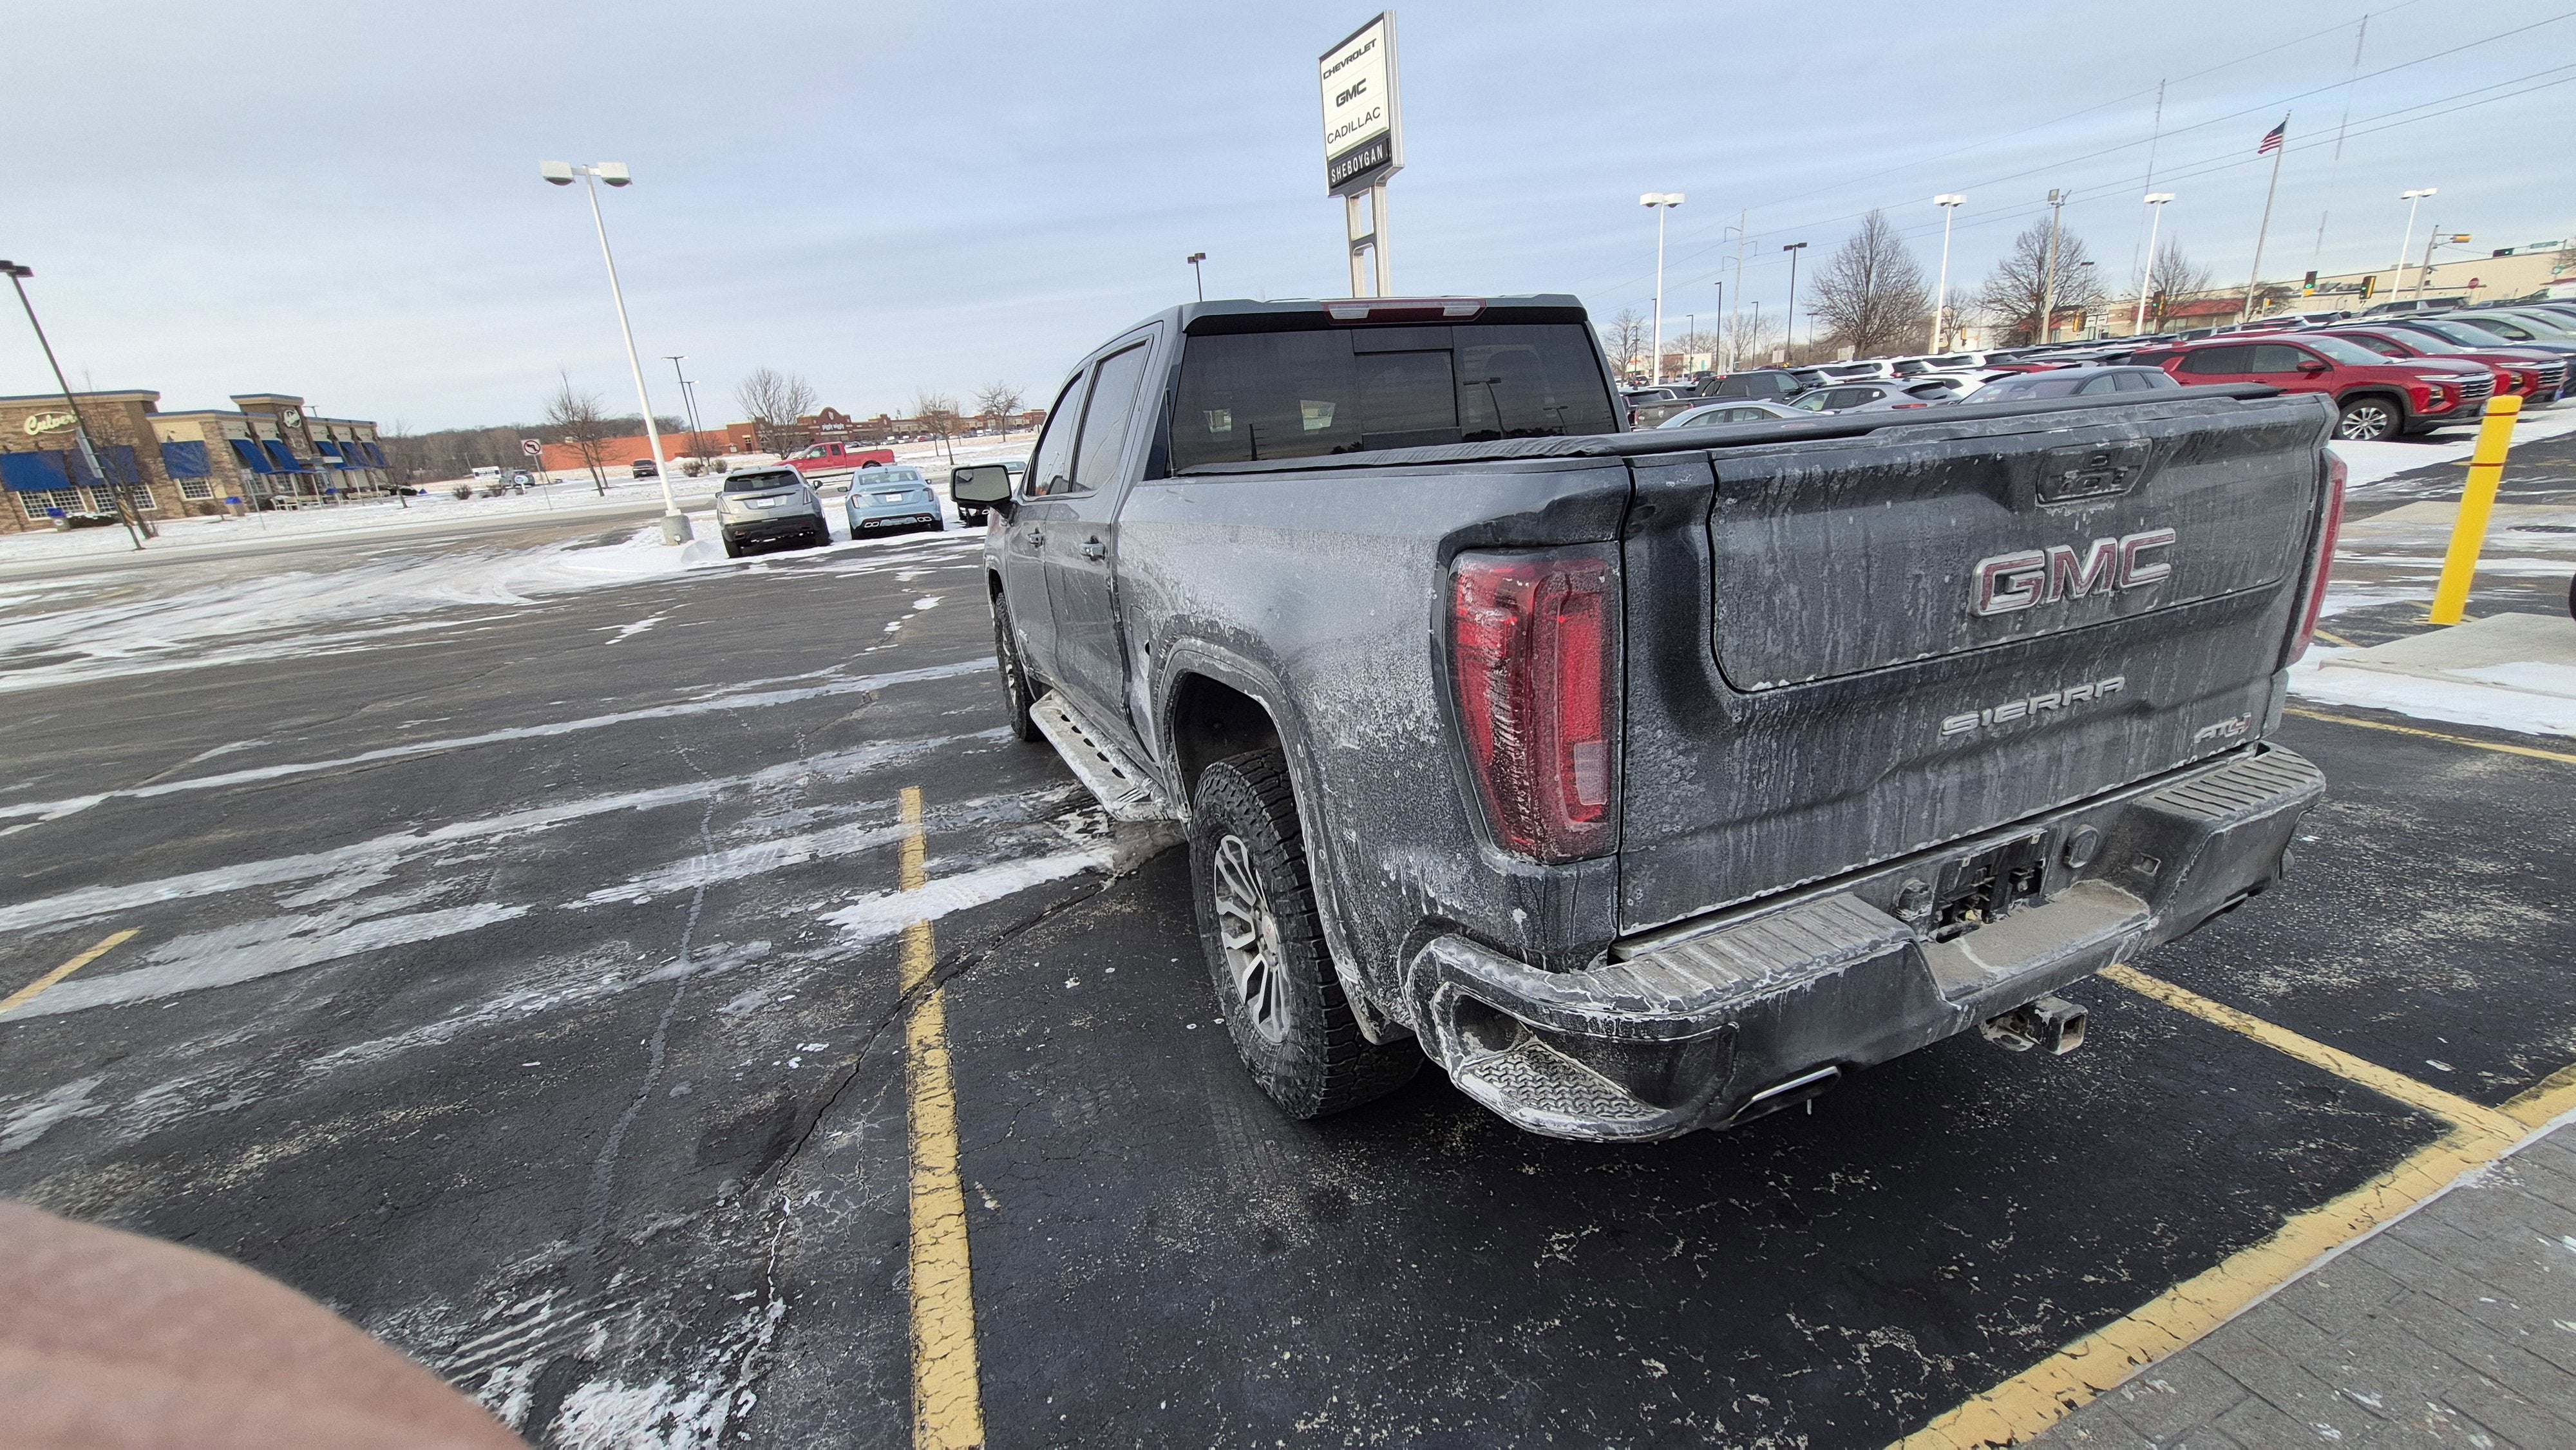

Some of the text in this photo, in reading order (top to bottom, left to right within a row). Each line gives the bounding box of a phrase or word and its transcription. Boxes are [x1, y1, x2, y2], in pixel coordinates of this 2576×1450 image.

[1323, 38, 1377, 80] CHEVROLET
[1336, 78, 1367, 108] GMC
[1327, 106, 1381, 145] CADILLAC
[1331, 144, 1383, 184] SHEBOYGAN
[1970, 527, 2175, 617] GMC
[1940, 676, 2125, 736] SIERRA
[2193, 711, 2251, 744] AT4
